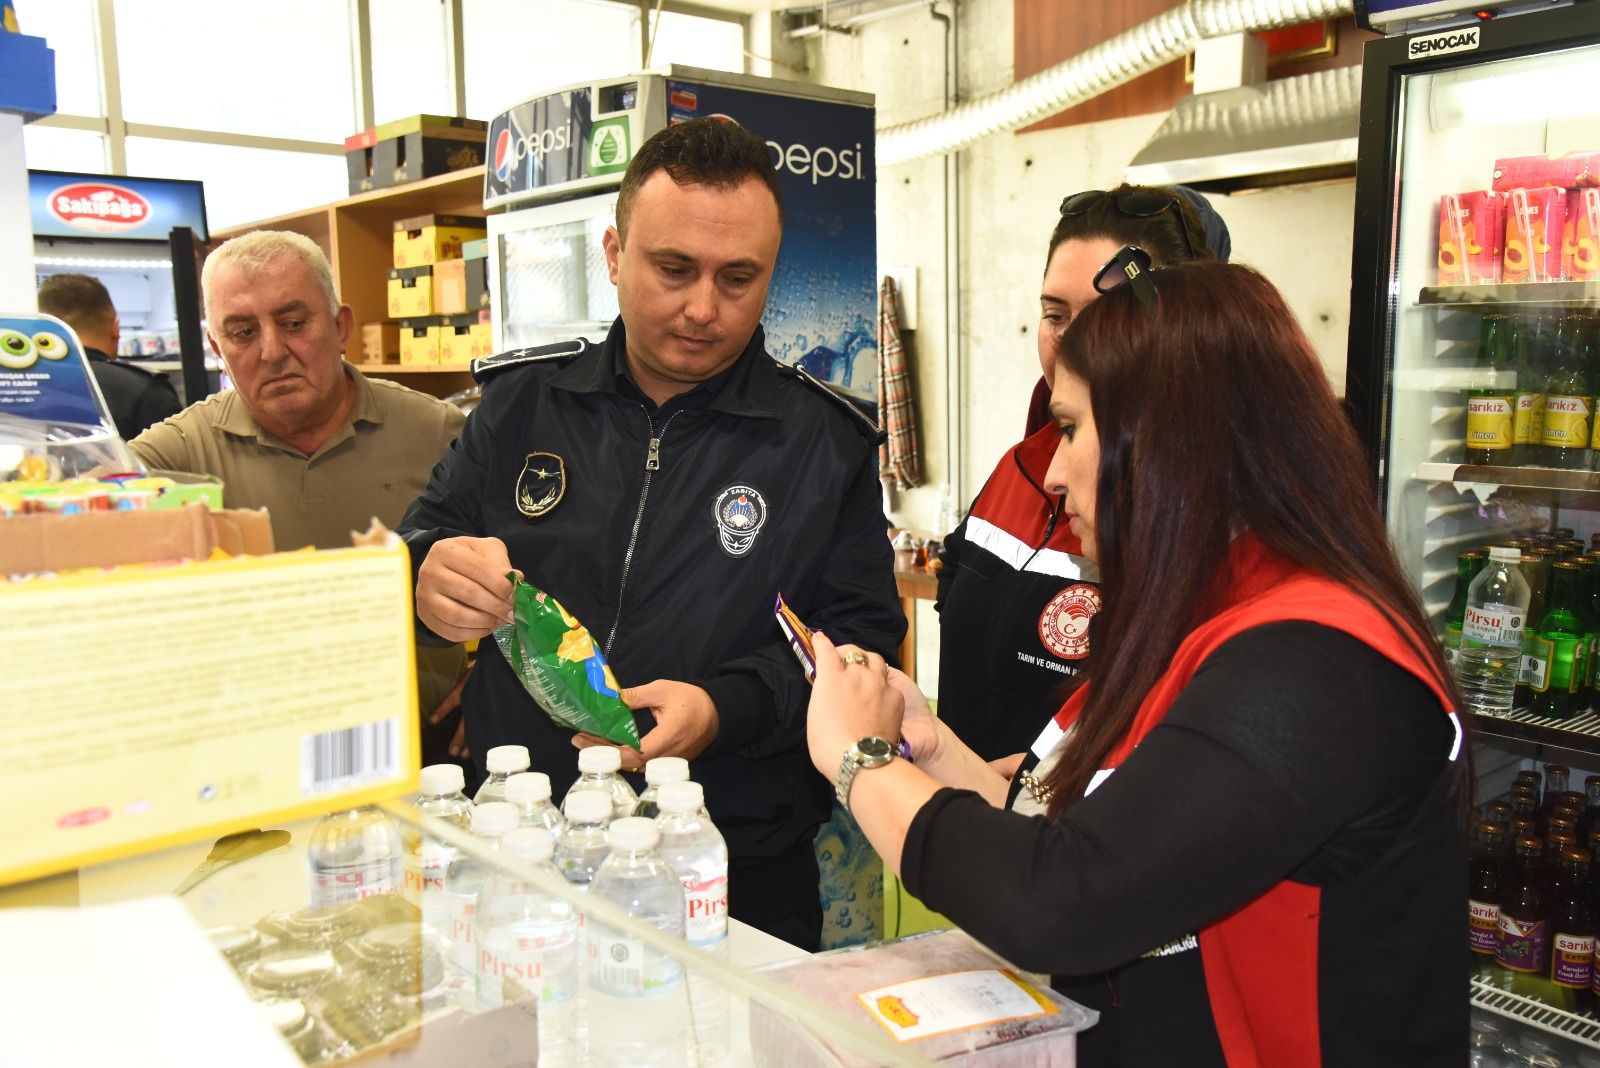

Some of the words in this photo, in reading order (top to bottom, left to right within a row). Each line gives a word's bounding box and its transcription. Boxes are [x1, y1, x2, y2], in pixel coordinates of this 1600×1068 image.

[512, 118, 571, 171] pepsi
[1017, 651, 1035, 664] TARIM
[1036, 657, 1045, 668] VE
[1045, 660, 1071, 675] ORMAN
